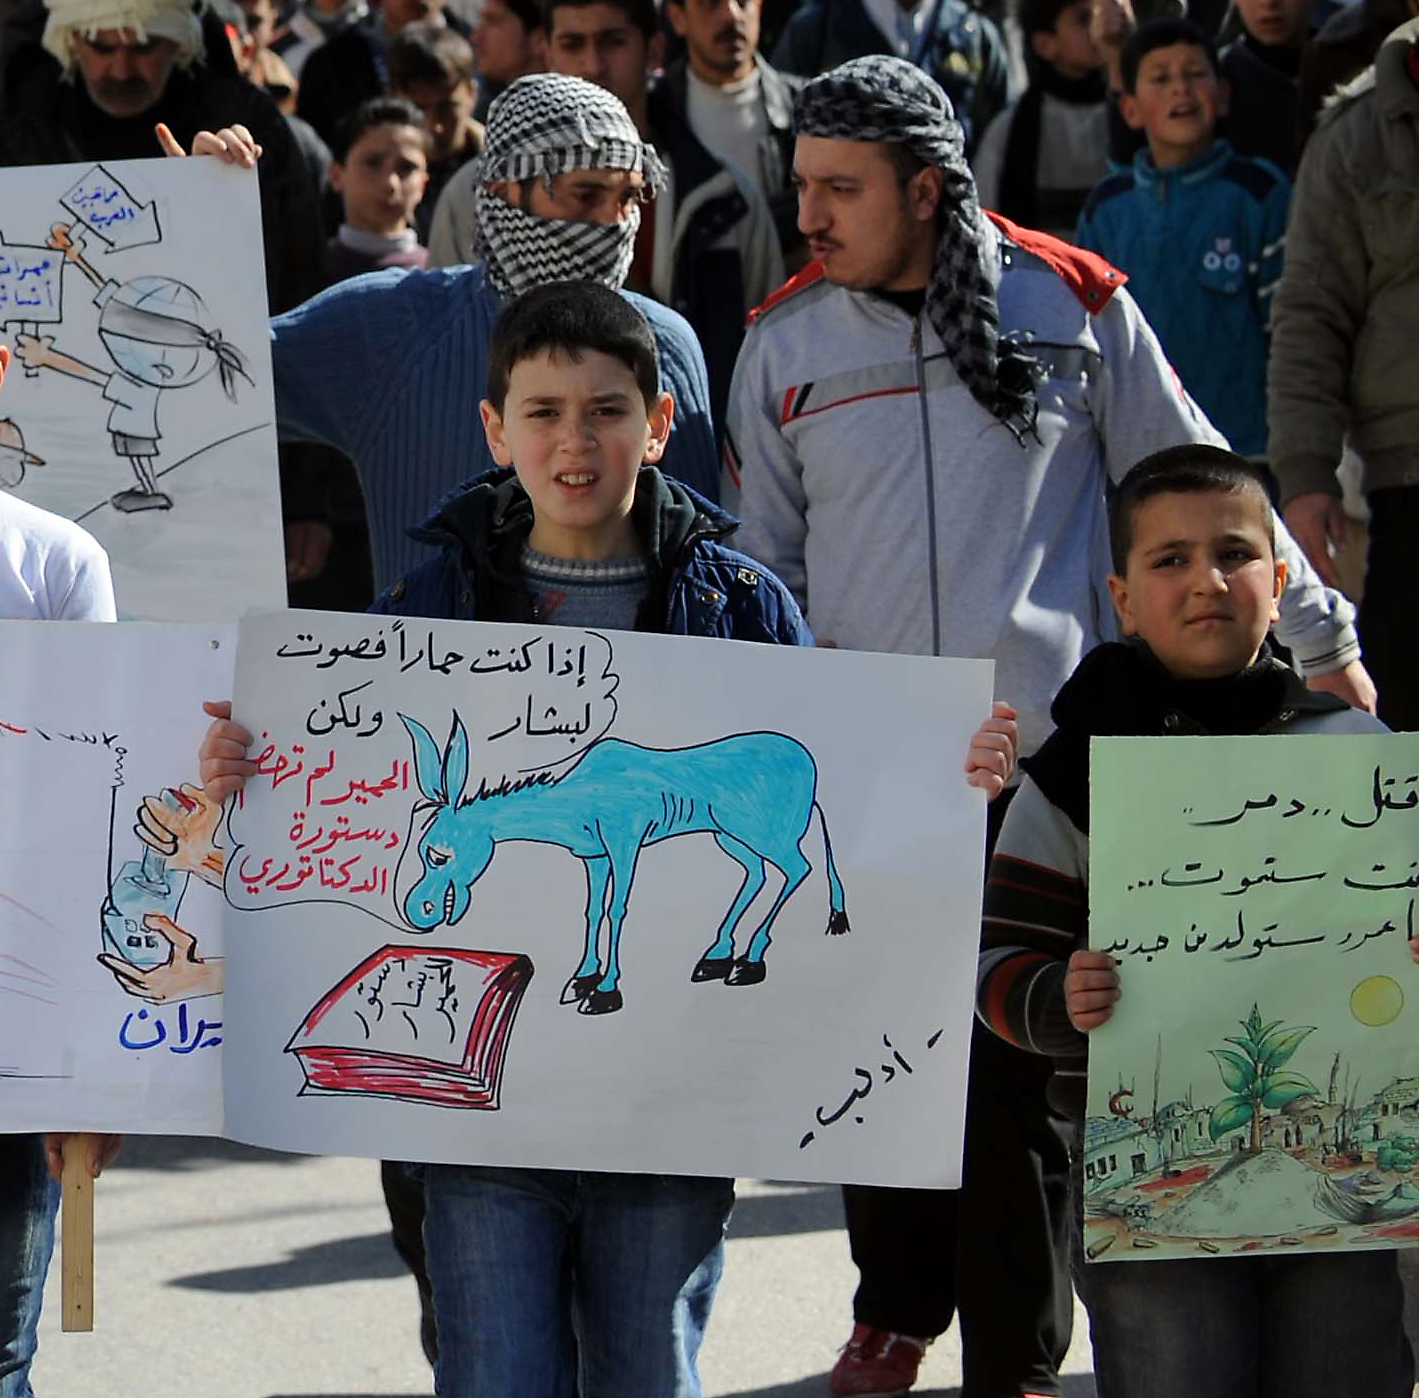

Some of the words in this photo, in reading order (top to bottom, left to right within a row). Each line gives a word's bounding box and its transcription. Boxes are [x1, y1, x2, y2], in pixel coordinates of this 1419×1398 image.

[275, 630, 386, 669] فصوت
[469, 635, 543, 676] كنت
[547, 642, 587, 688] إذا
[305, 680, 384, 738] ولكن
[487, 694, 592, 745] لبشار
[305, 749, 335, 808] لم
[319, 759, 409, 806] الحمير
[118, 1002, 224, 1054] يران
